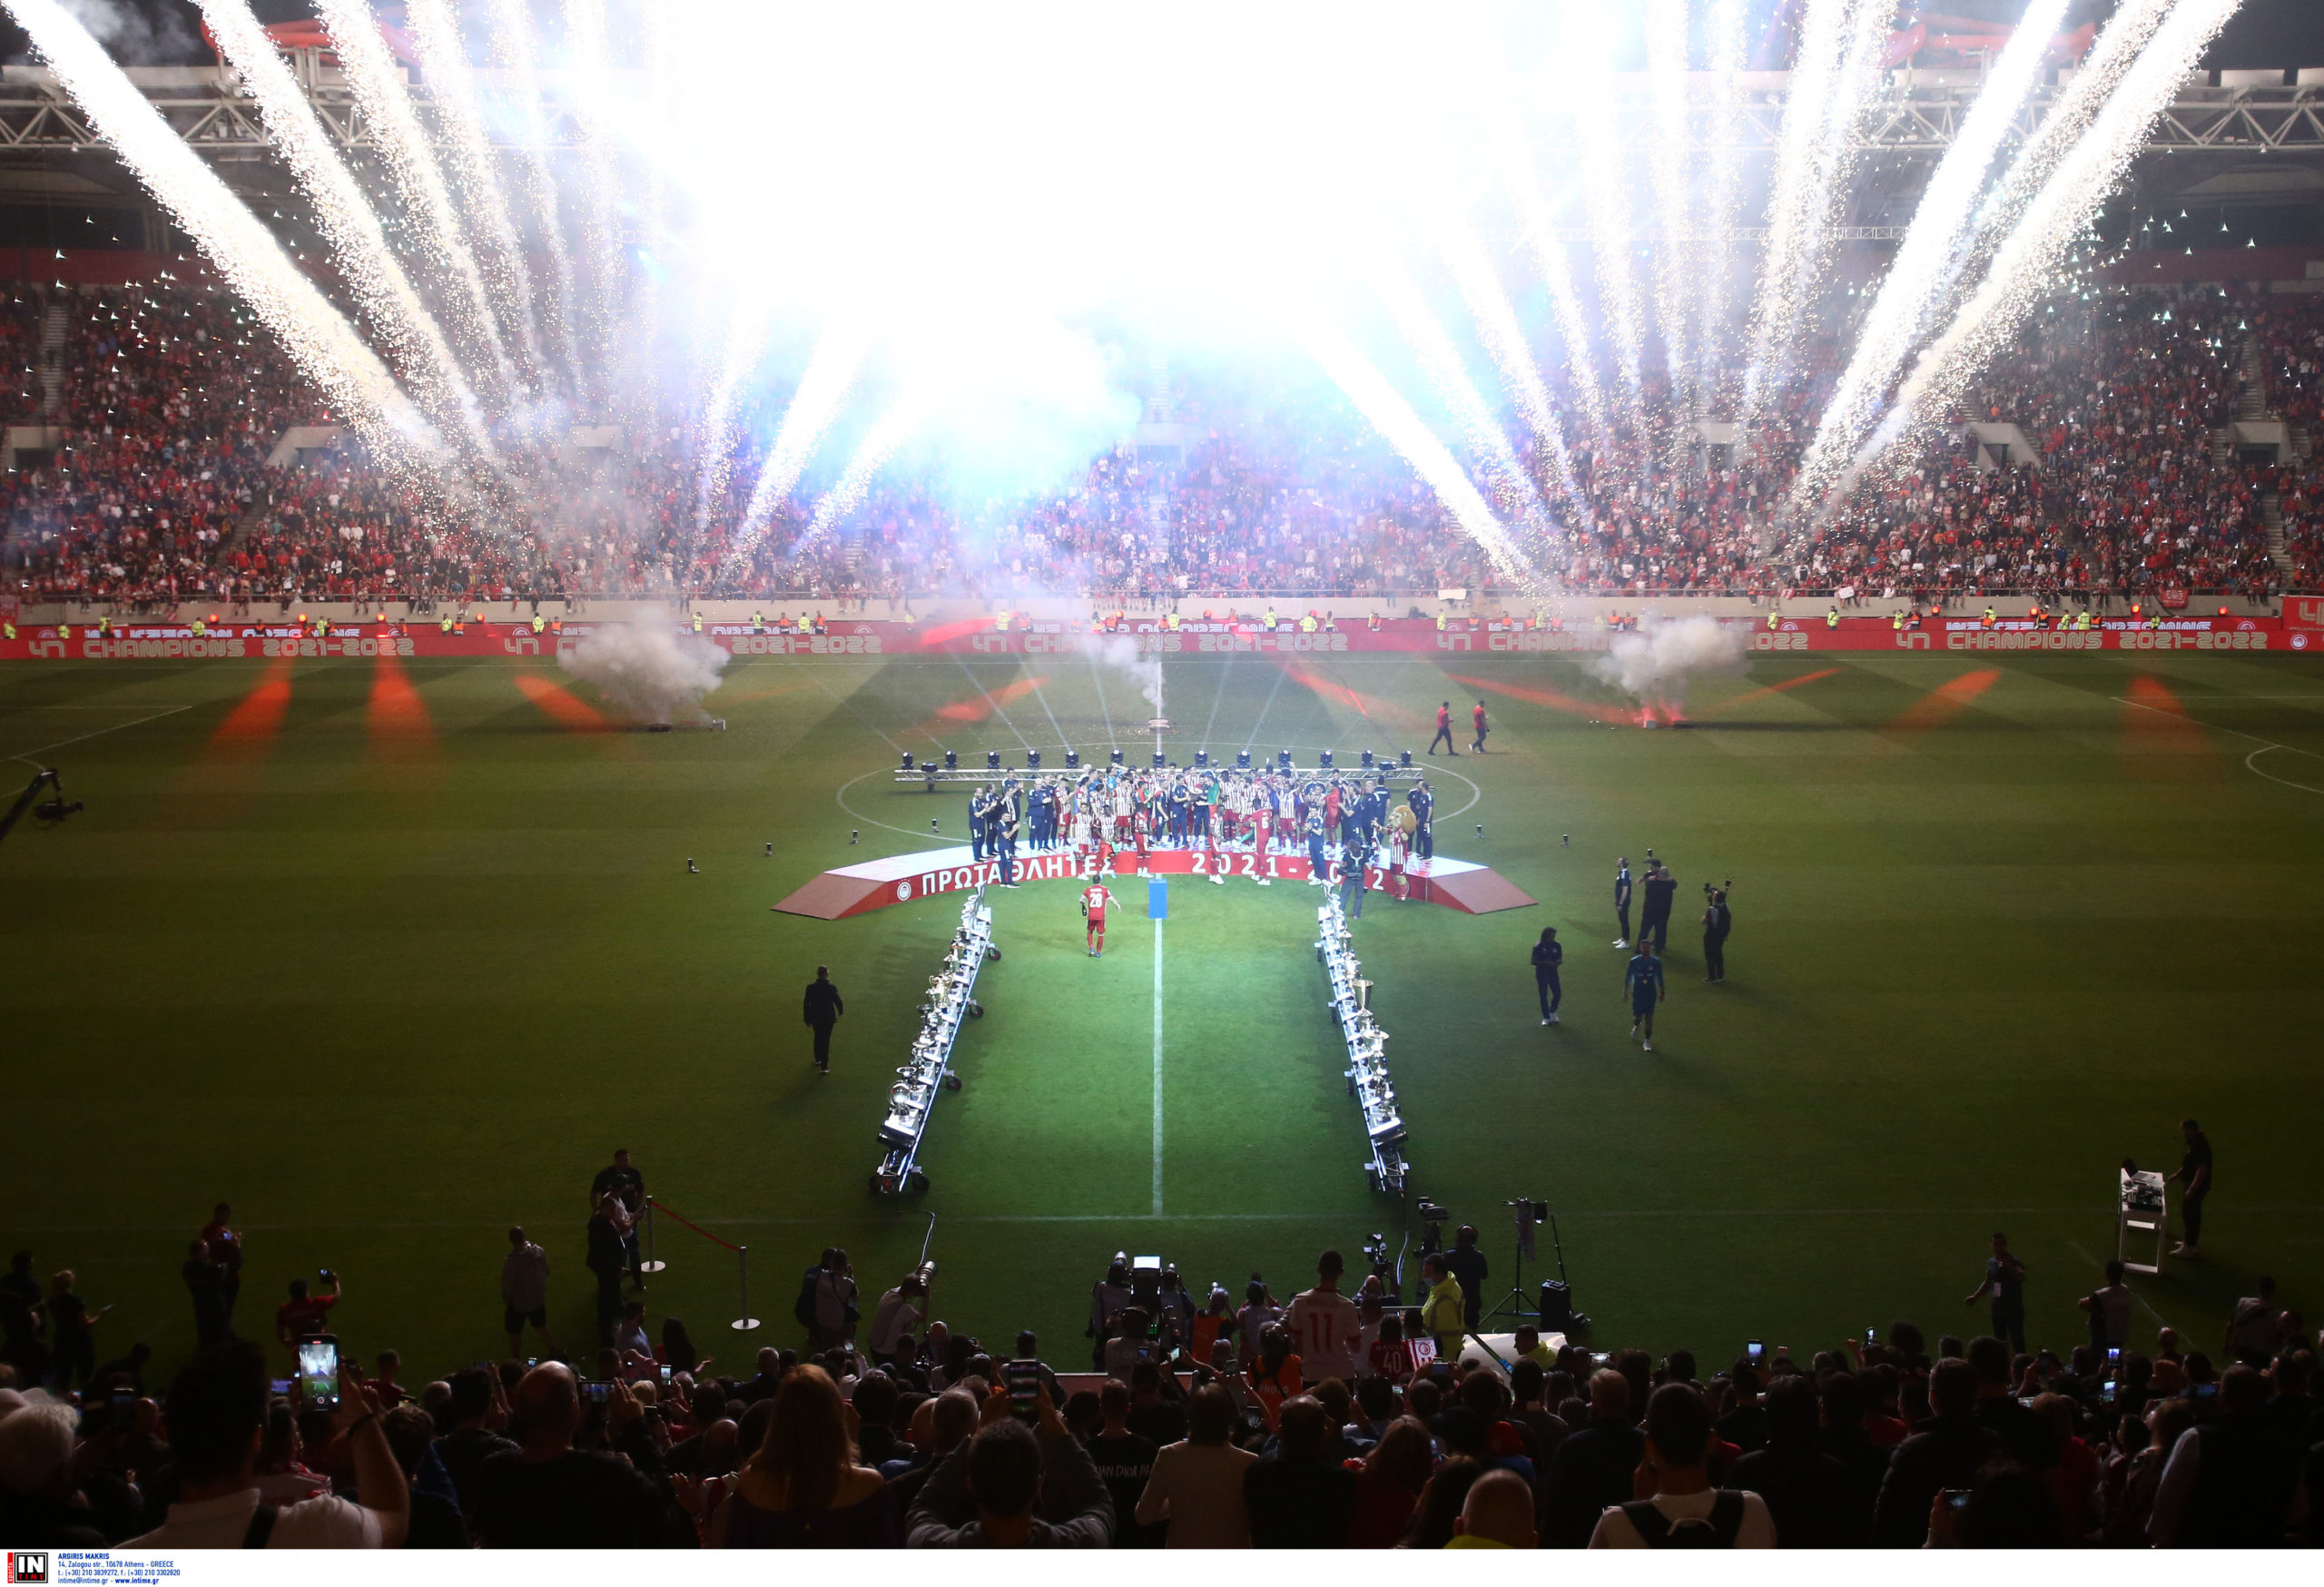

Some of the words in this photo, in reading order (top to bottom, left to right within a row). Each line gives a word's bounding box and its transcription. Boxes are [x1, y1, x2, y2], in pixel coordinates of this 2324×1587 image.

[83, 638, 245, 658] CHAMPIONS
[262, 638, 415, 657] 2021-2022
[731, 636, 882, 655] 2021-2022
[1198, 634, 1349, 652] 2021-2022
[1946, 631, 2102, 650] CHAMPIONS
[2120, 631, 2268, 650] 2021-2022
[1383, 1350, 1403, 1374] 40
